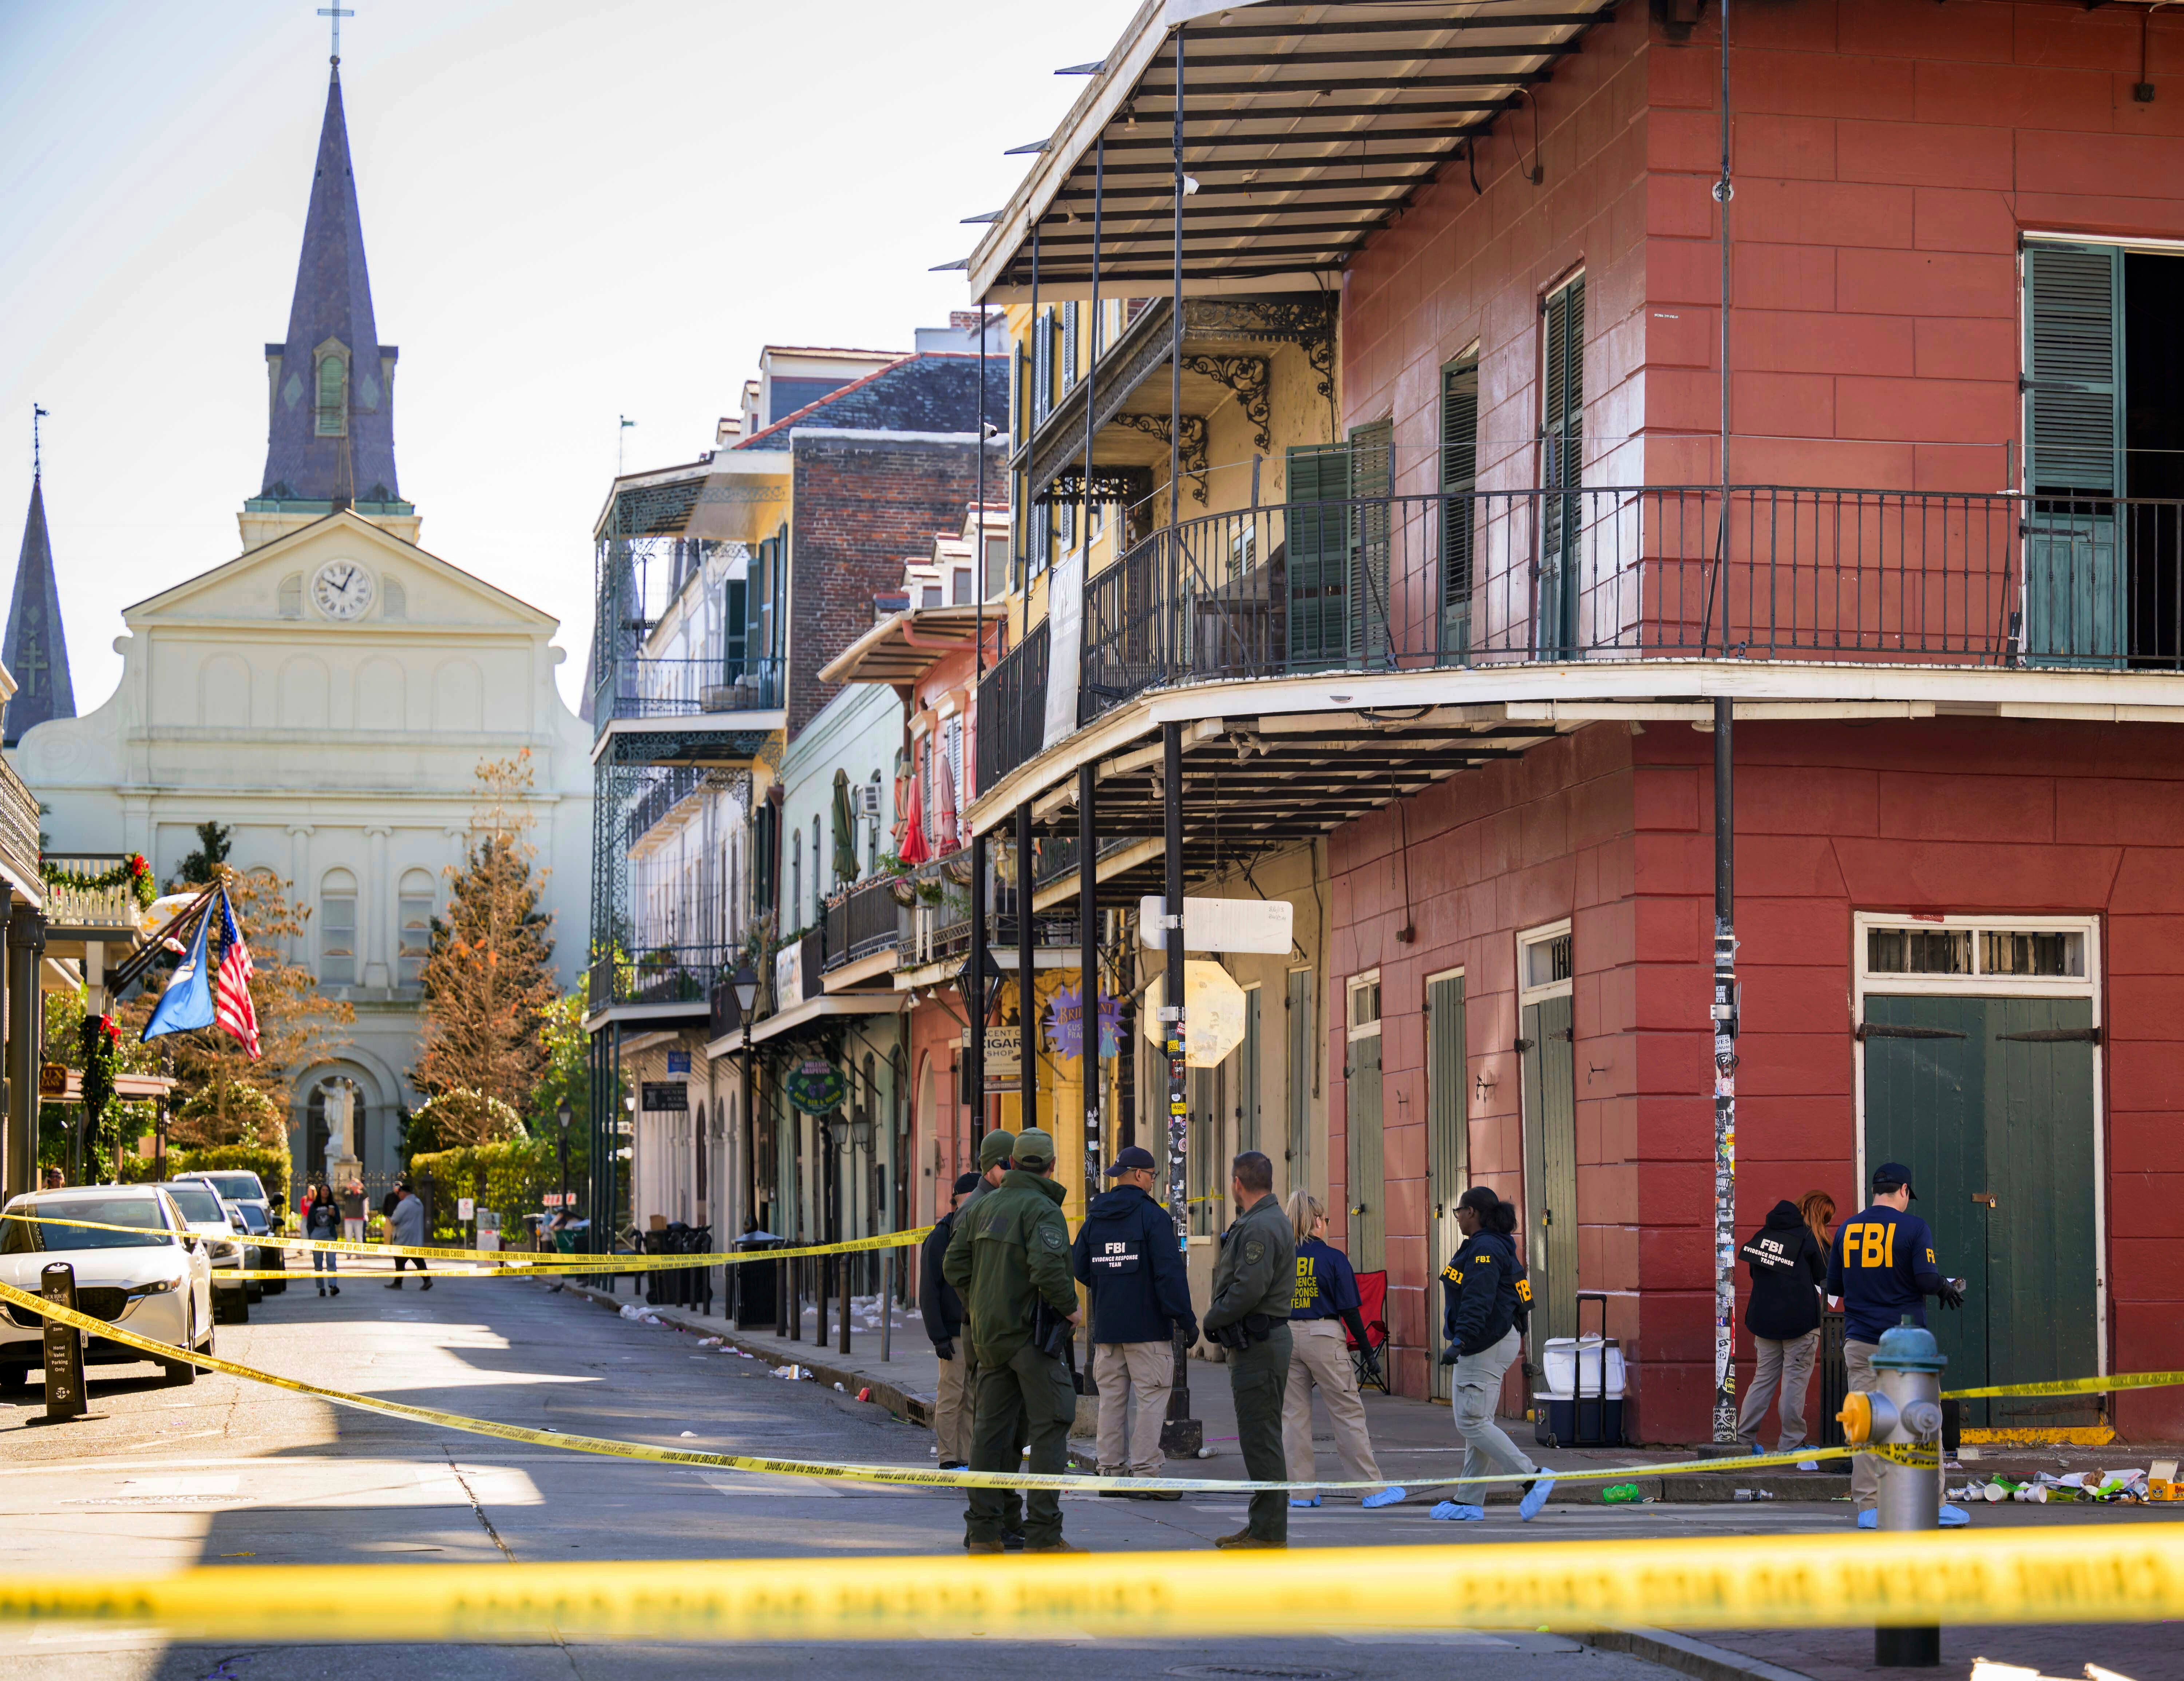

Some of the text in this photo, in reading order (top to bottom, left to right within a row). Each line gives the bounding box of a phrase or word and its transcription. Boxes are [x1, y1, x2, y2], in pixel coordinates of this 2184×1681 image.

[963, 1029, 1012, 1037] CCENT
[1105, 1242, 1125, 1254] FBI
[1760, 1238, 1784, 1254] FBI
[1843, 1223, 1896, 1268] FBI
[1743, 1245, 1794, 1267] EVIDENCE RESPONSE
[1761, 1257, 1774, 1266] TEAM
[1926, 1248, 1935, 1264] FB
[1297, 1257, 1314, 1277] BI
[1443, 1265, 1464, 1284] FBI
[1295, 1277, 1317, 1287] ENCE
[1293, 1287, 1319, 1298] PONSE
[1515, 1279, 1533, 1304] FB
